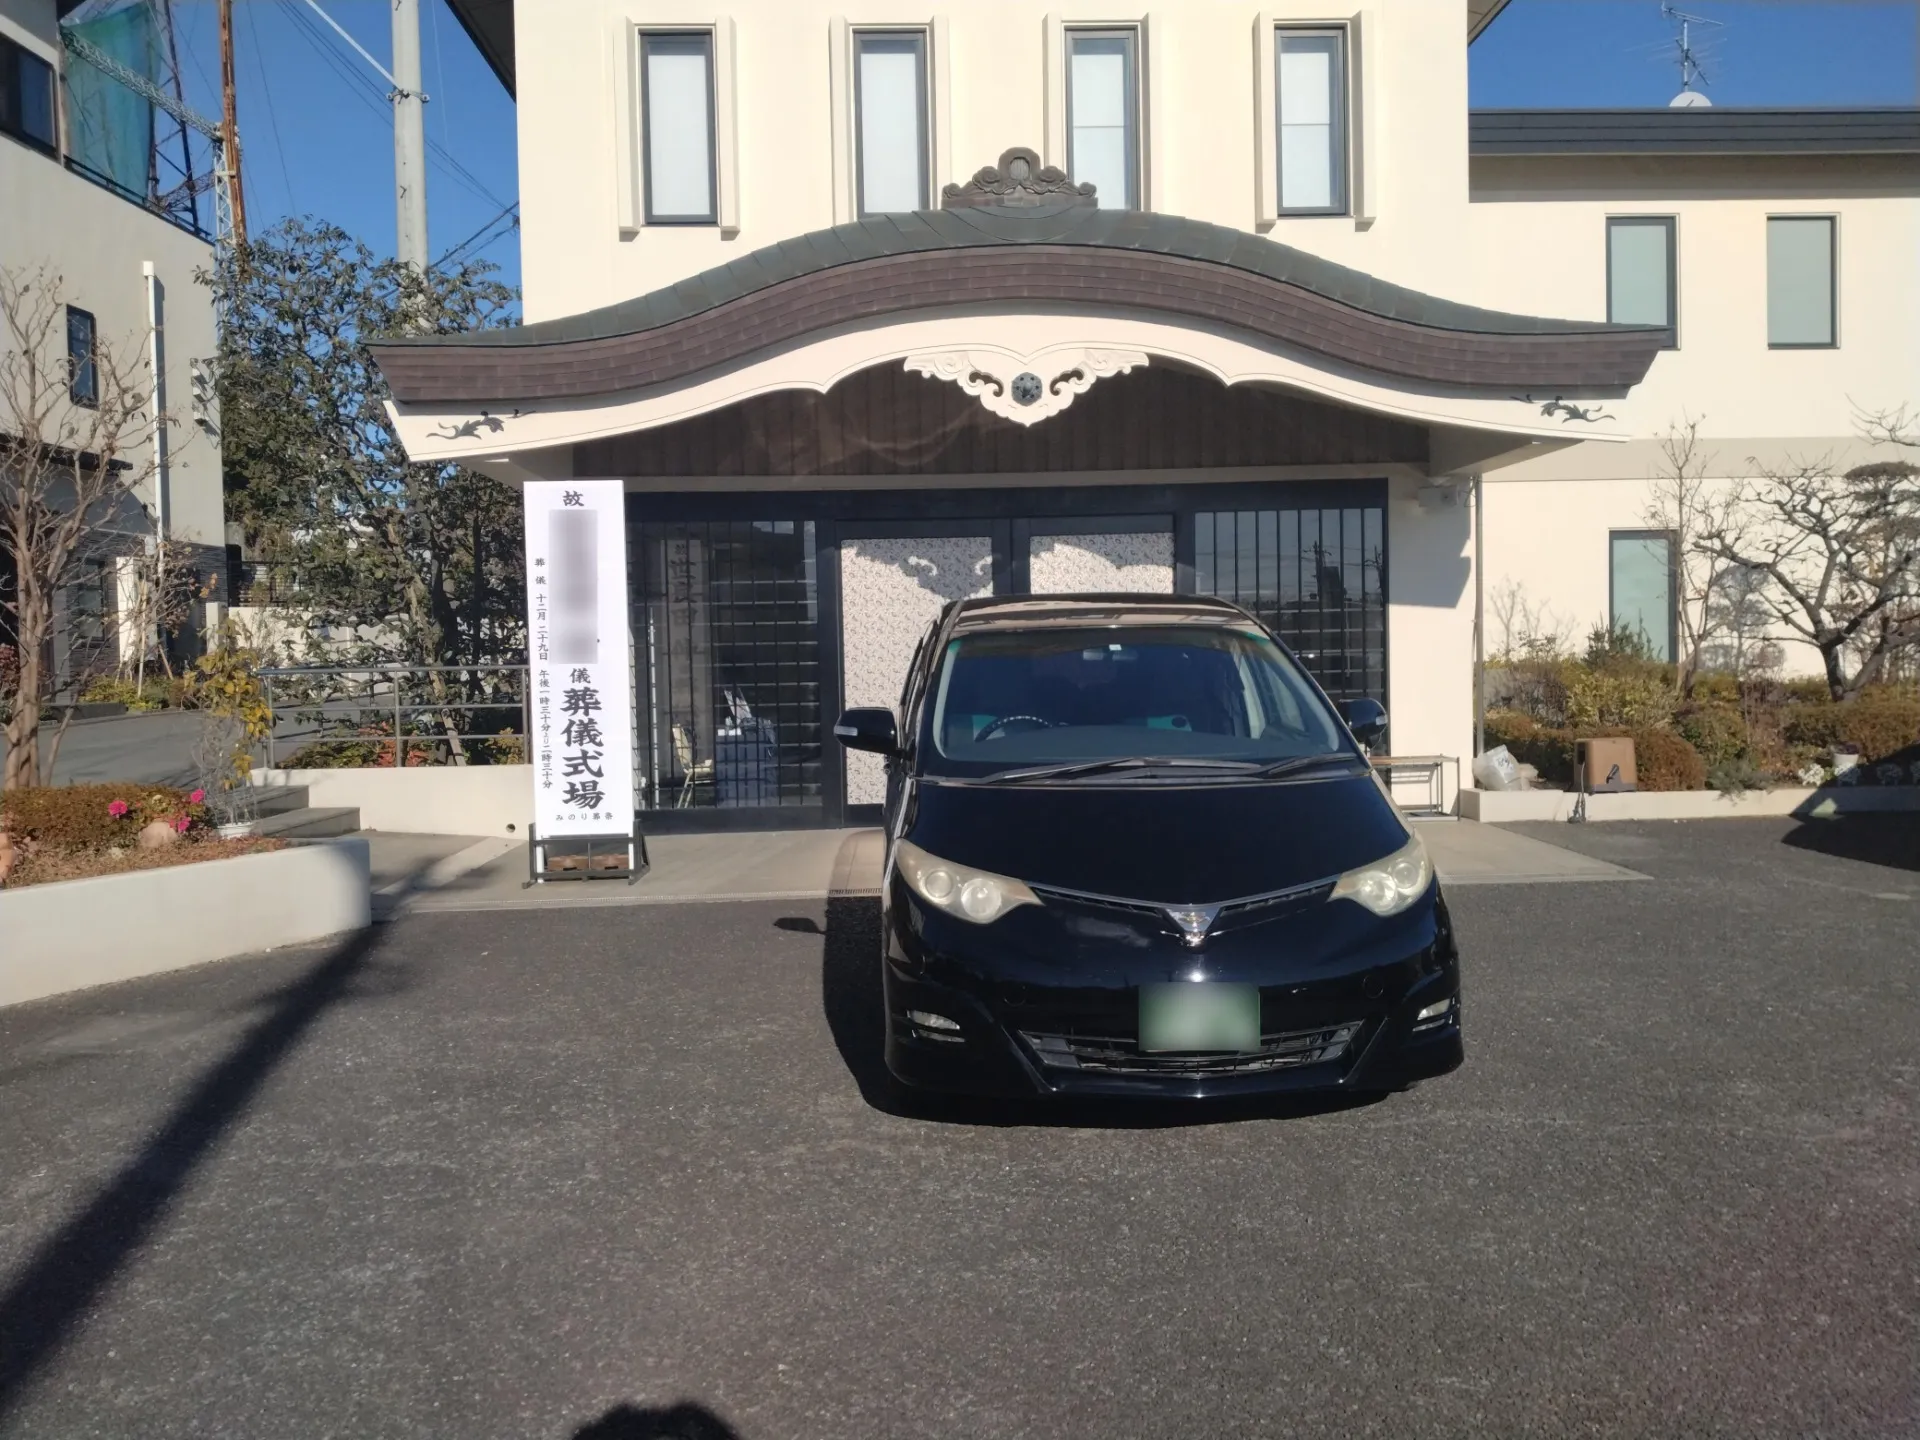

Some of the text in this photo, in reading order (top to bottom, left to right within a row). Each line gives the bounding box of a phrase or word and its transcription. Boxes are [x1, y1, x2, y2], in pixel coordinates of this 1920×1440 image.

[562, 490, 585, 507] 故
[559, 687, 606, 810] 葬儀式場
